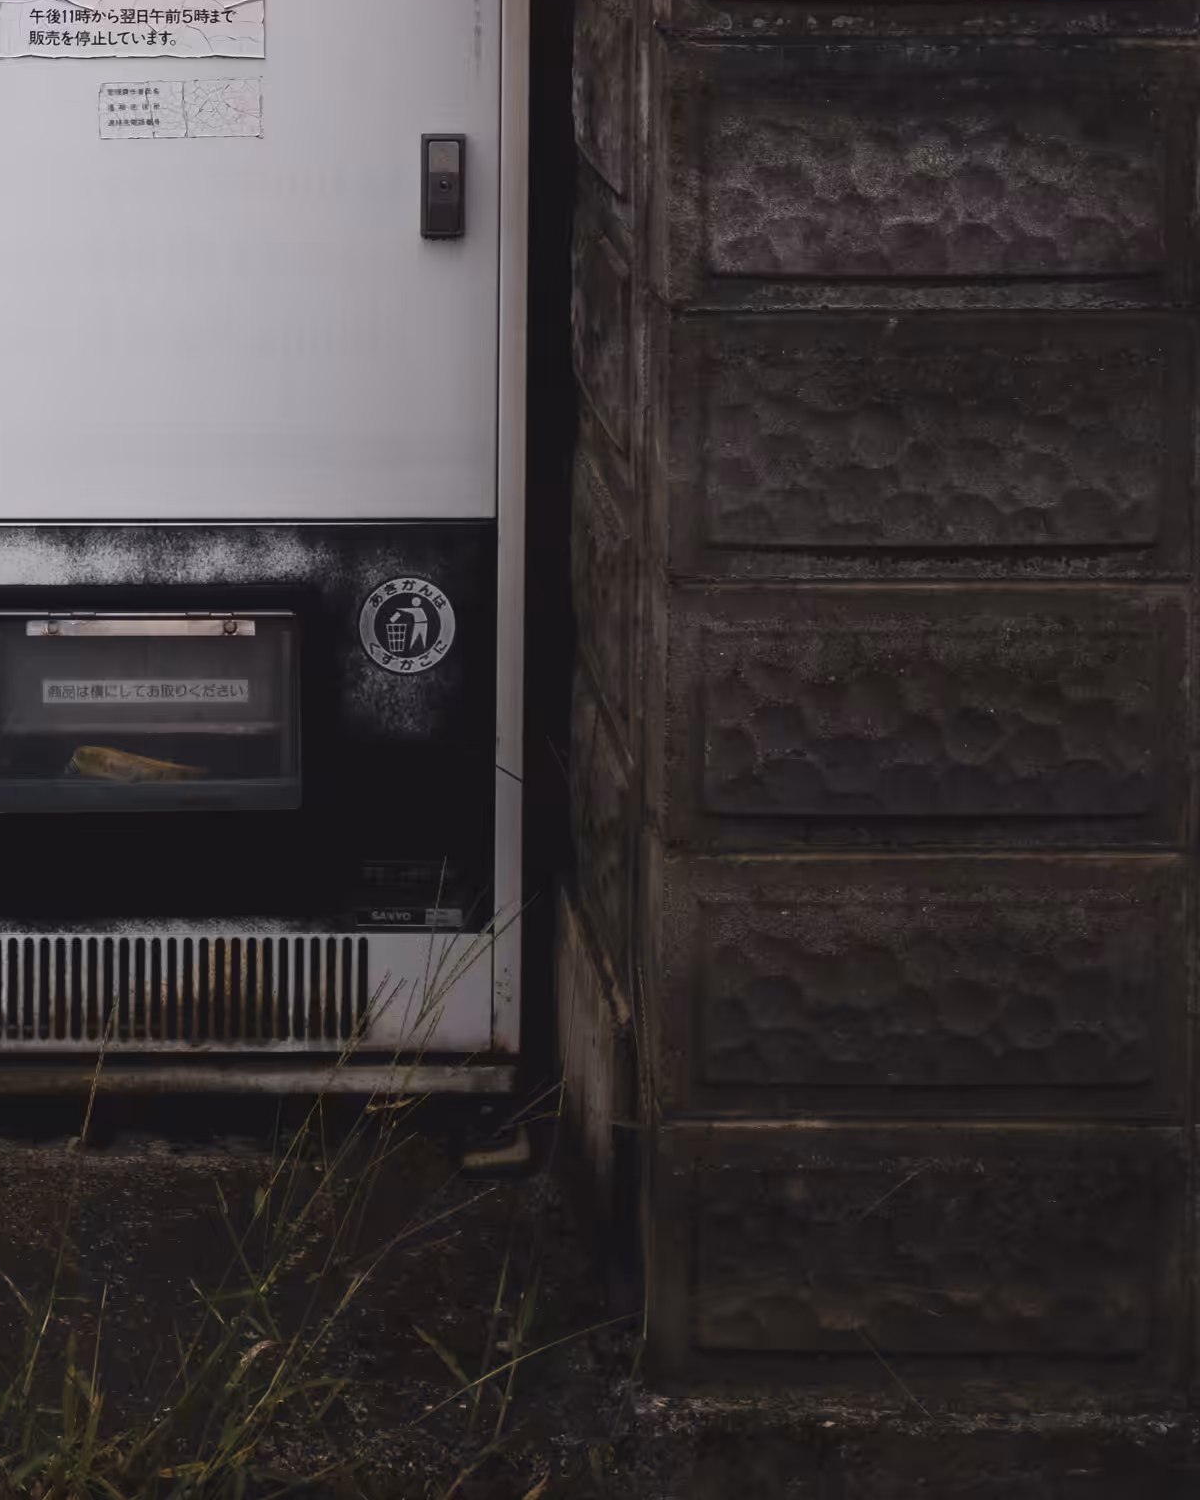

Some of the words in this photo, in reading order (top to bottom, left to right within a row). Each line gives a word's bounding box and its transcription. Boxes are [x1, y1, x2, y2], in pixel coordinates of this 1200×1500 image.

[29, 9, 237, 24] 午後11時から翌日午前5時まで
[29, 30, 177, 47] 販売を停止しています。
[368, 579, 448, 609] あきかんは
[368, 639, 448, 671] くずかごに
[371, 910, 412, 921] SANYO
